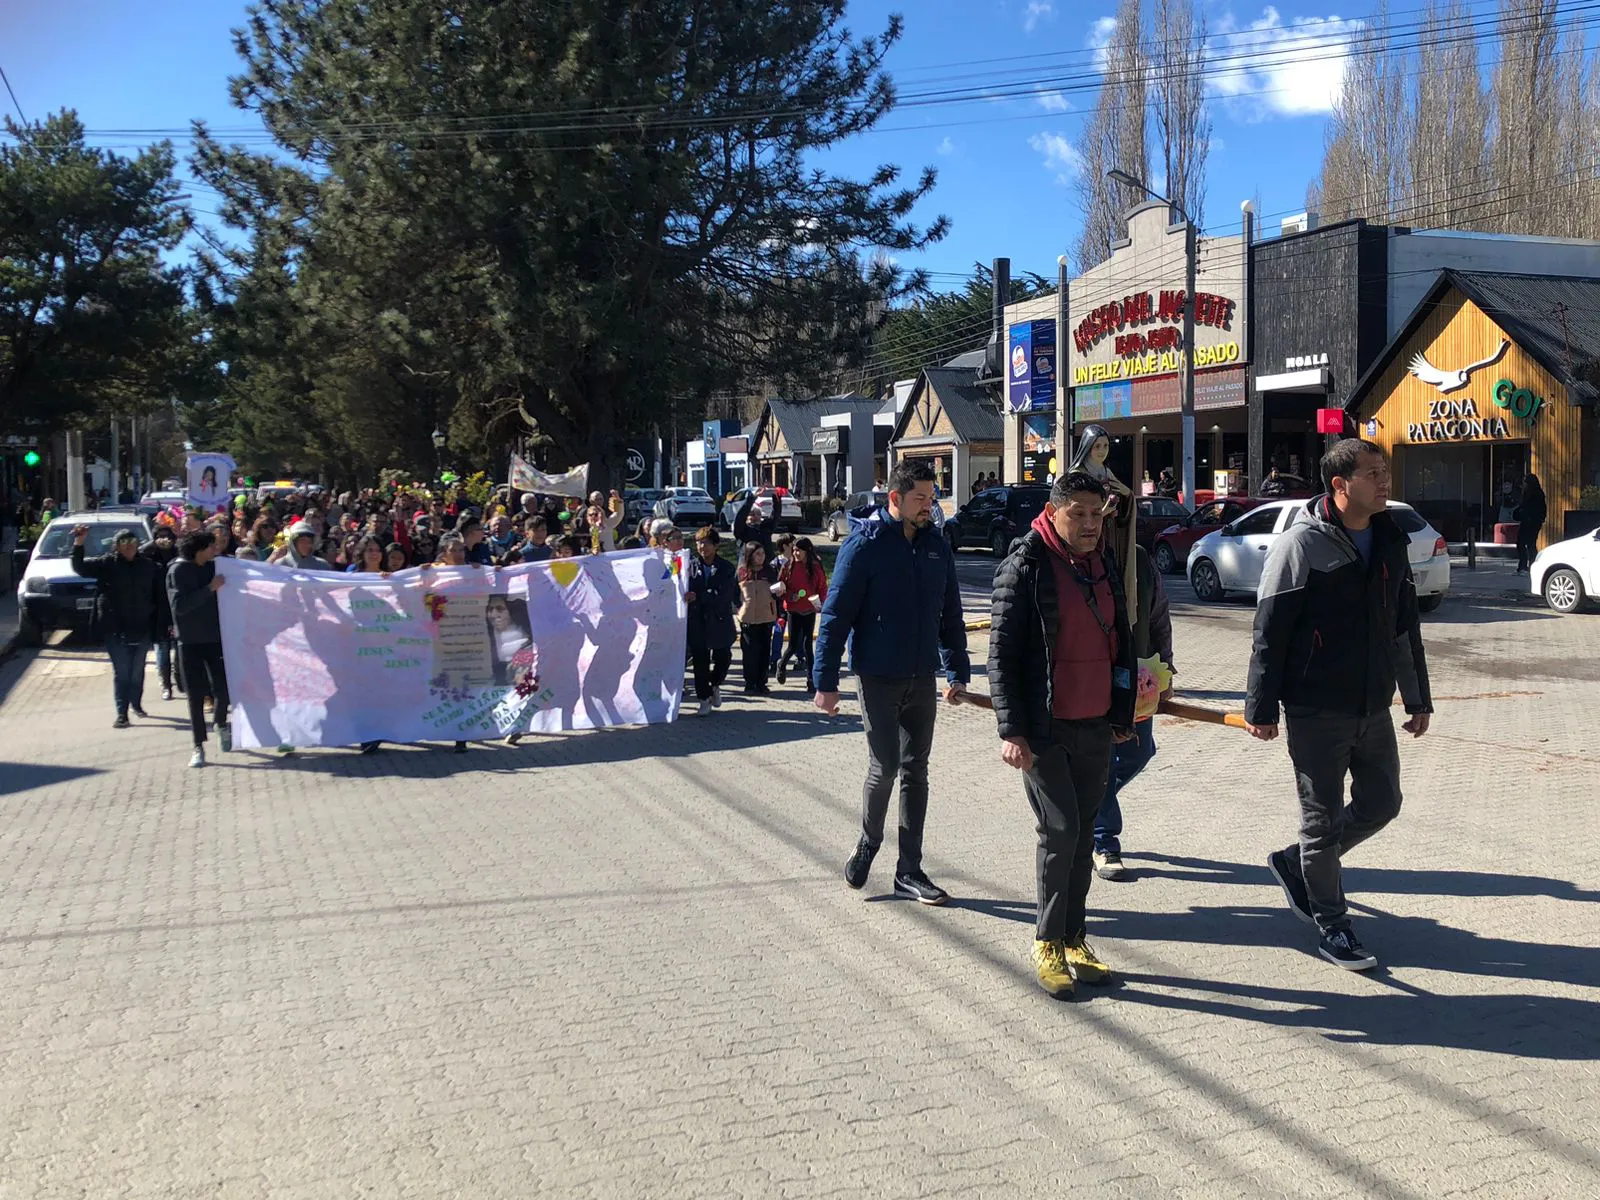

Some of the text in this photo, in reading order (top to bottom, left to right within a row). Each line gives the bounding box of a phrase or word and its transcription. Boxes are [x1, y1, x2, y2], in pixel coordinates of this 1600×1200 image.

[1073, 300, 1122, 354] MUSEO
[1124, 290, 1151, 324] DEL
[1073, 365, 1089, 384] UN
[1089, 359, 1122, 381] FELIZ
[1122, 353, 1159, 377] VIAJE
[1160, 350, 1179, 371] AL
[1429, 400, 1477, 418] ZONA
[1492, 378, 1541, 427] GO!
[1407, 418, 1508, 440] PATAGONIA
